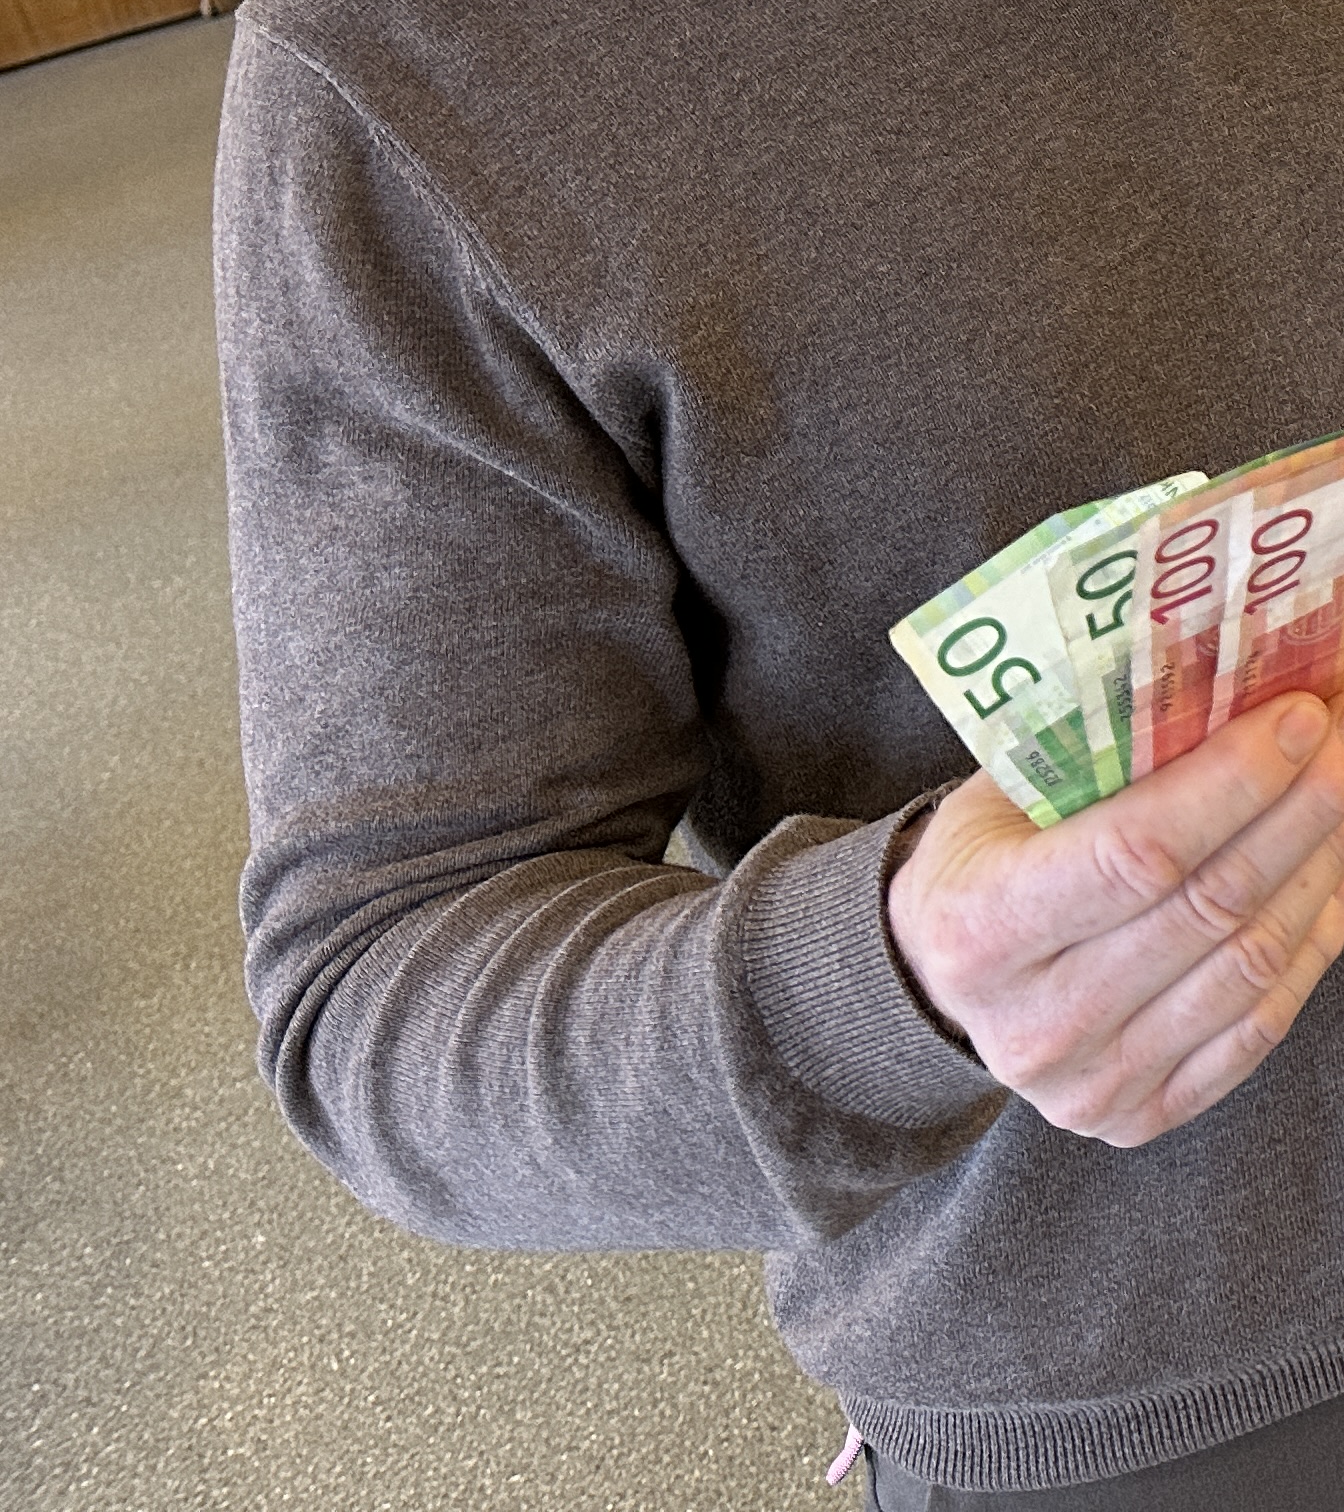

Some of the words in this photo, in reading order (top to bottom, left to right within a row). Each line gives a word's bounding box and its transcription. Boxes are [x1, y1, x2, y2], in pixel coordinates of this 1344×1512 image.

[1075, 549, 1138, 641] 50
[1150, 518, 1220, 626] 100
[1243, 508, 1314, 616] 100
[936, 615, 1043, 721] 50
